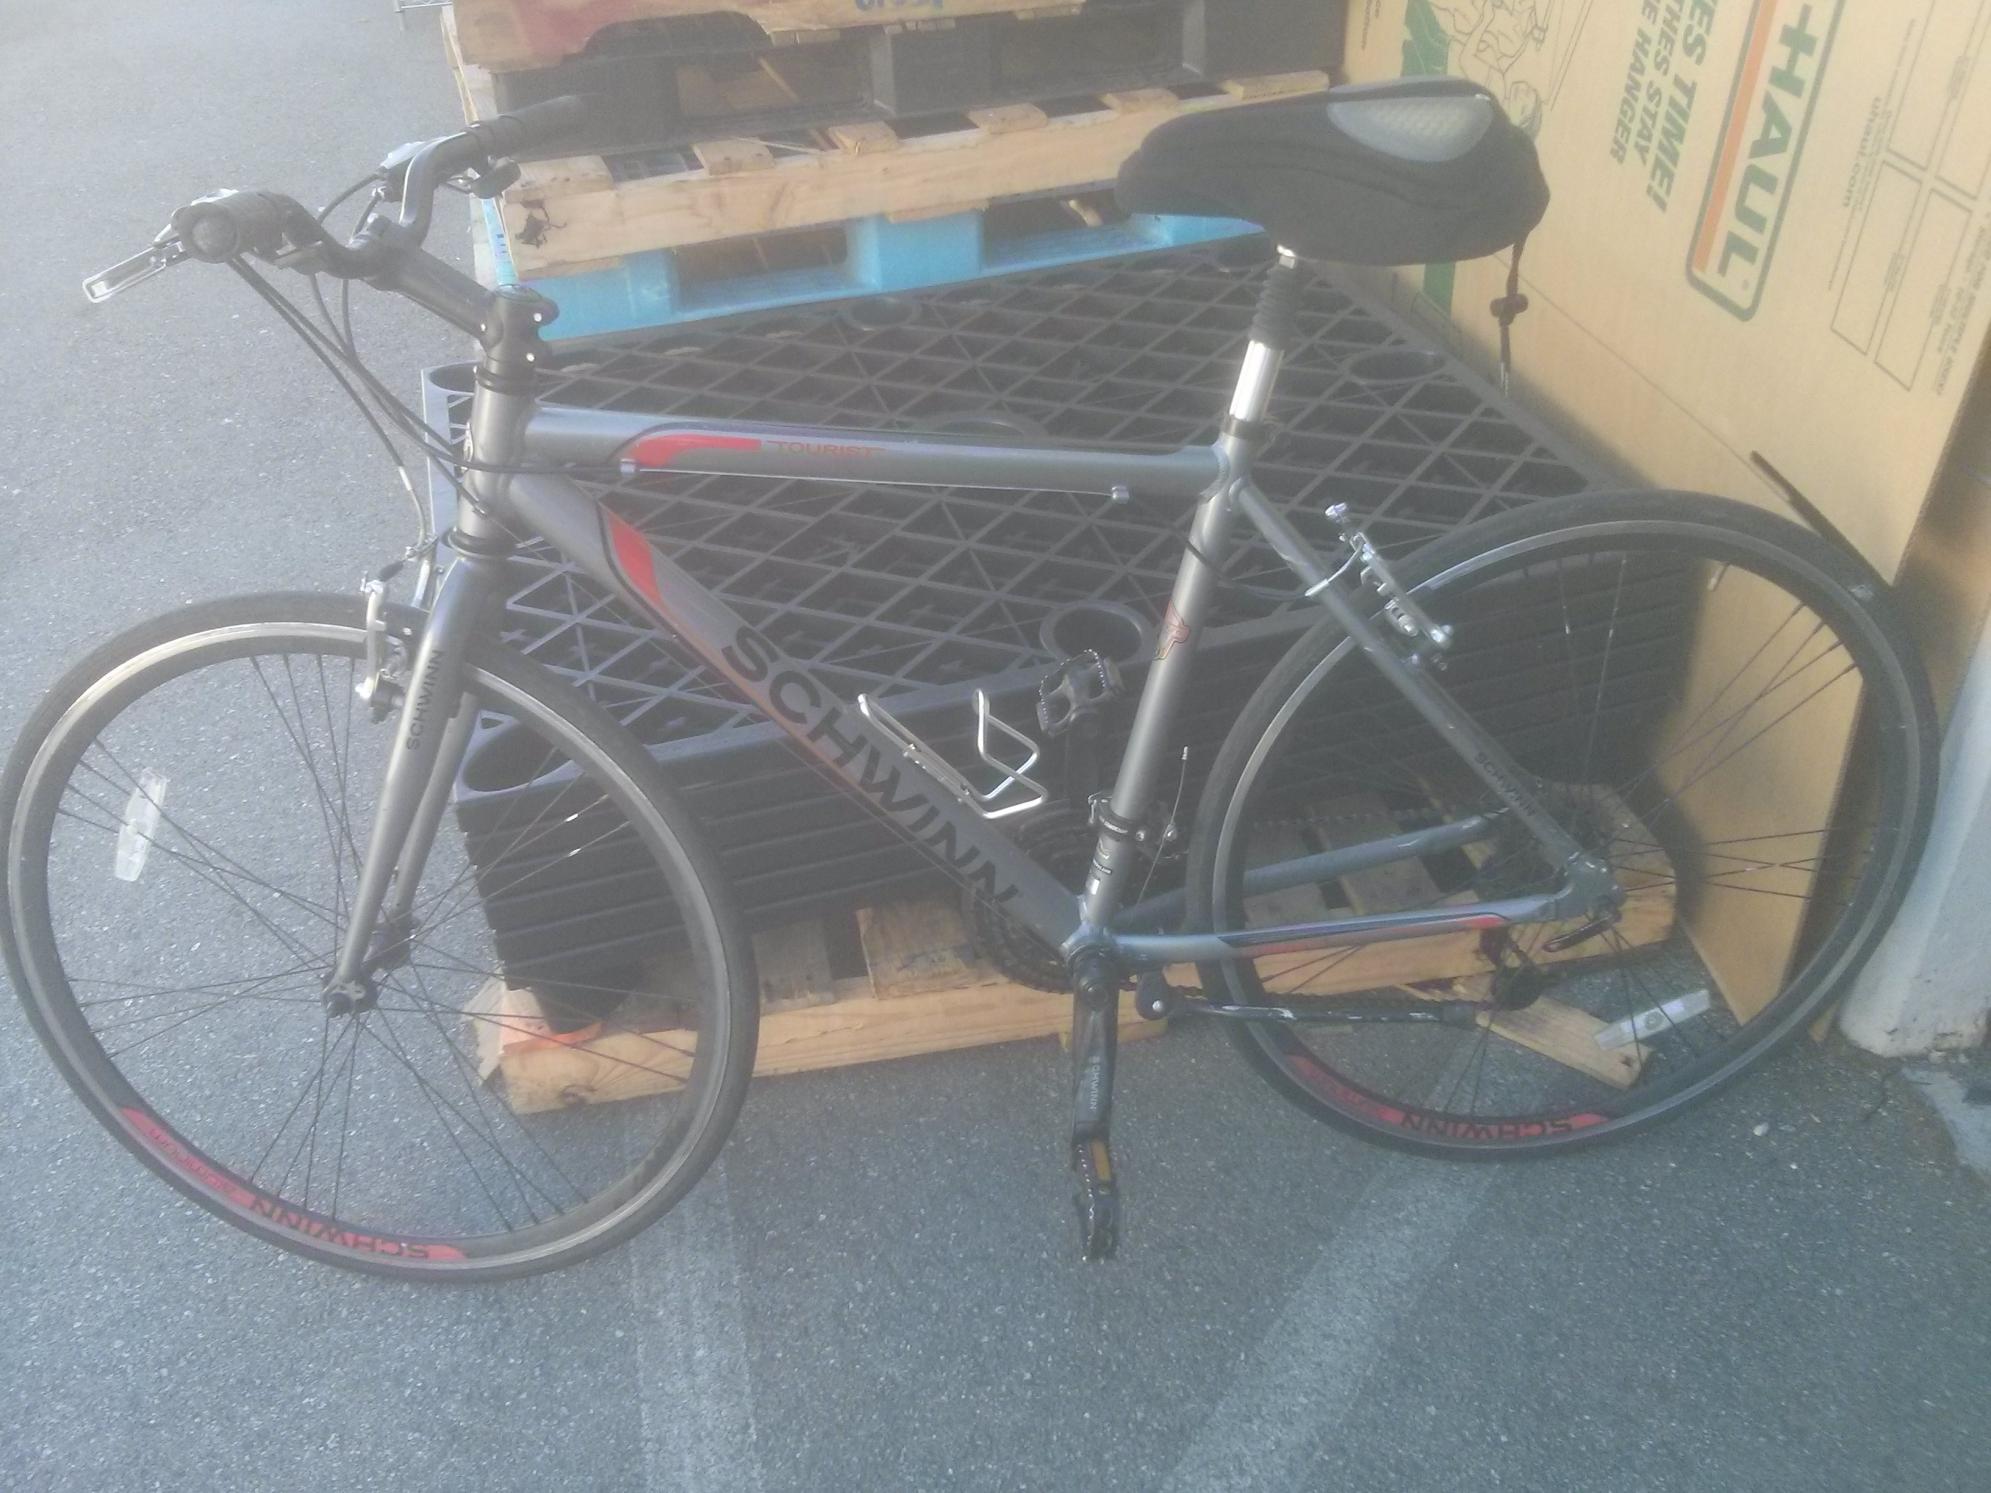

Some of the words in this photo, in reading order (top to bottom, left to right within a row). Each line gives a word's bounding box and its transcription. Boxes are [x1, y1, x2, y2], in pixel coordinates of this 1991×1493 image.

[1682, 0, 1718, 66] ES
[1609, 27, 1652, 165] HANGER
[1634, 80, 1662, 167] STAY
[1646, 73, 1698, 214] TIME!
[766, 440, 887, 458] TOURIST
[406, 649, 445, 751] SCHWINN
[721, 624, 1020, 911] SCHWINN
[1399, 1110, 1574, 1141] SCHWINN
[252, 1197, 429, 1260] SCHWINN
